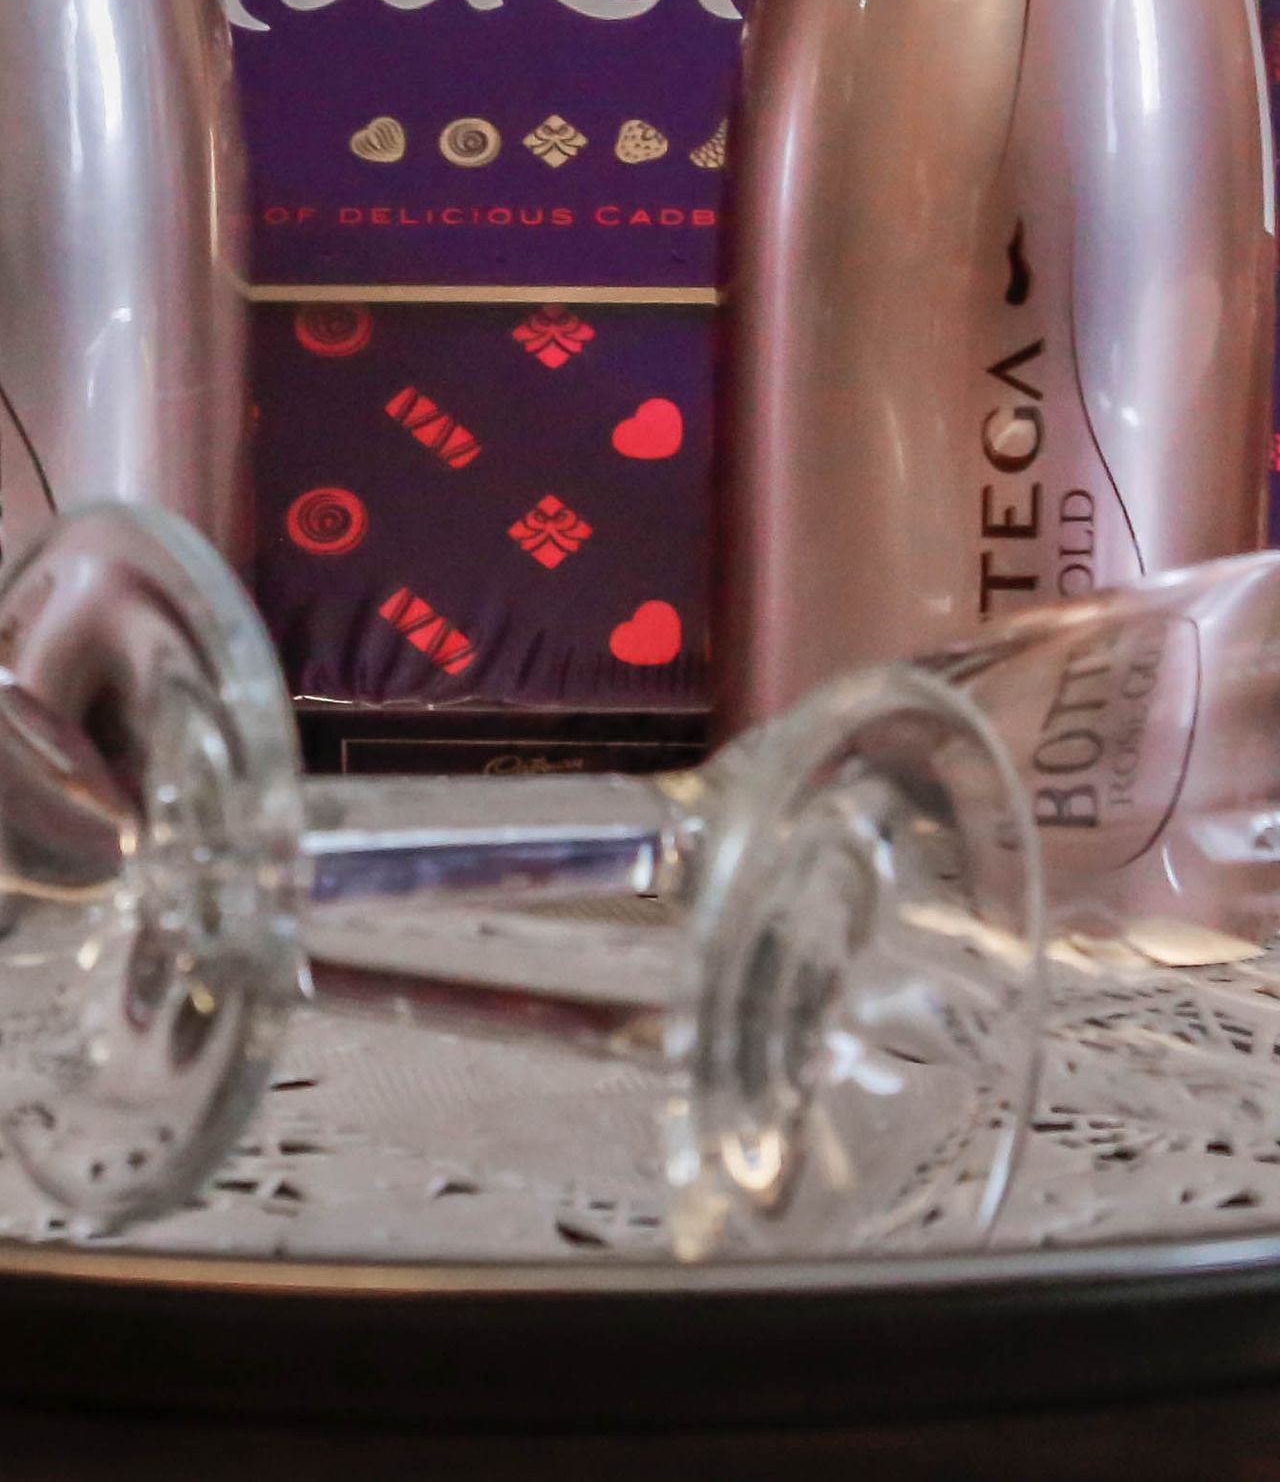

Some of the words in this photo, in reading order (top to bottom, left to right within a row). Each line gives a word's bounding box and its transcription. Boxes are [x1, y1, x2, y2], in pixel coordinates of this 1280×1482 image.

[265, 207, 315, 226] OF
[338, 207, 574, 226] DELICIOUS
[594, 205, 717, 227] CADB
[978, 338, 1046, 622] TEGA
[1058, 489, 1095, 597] OLD
